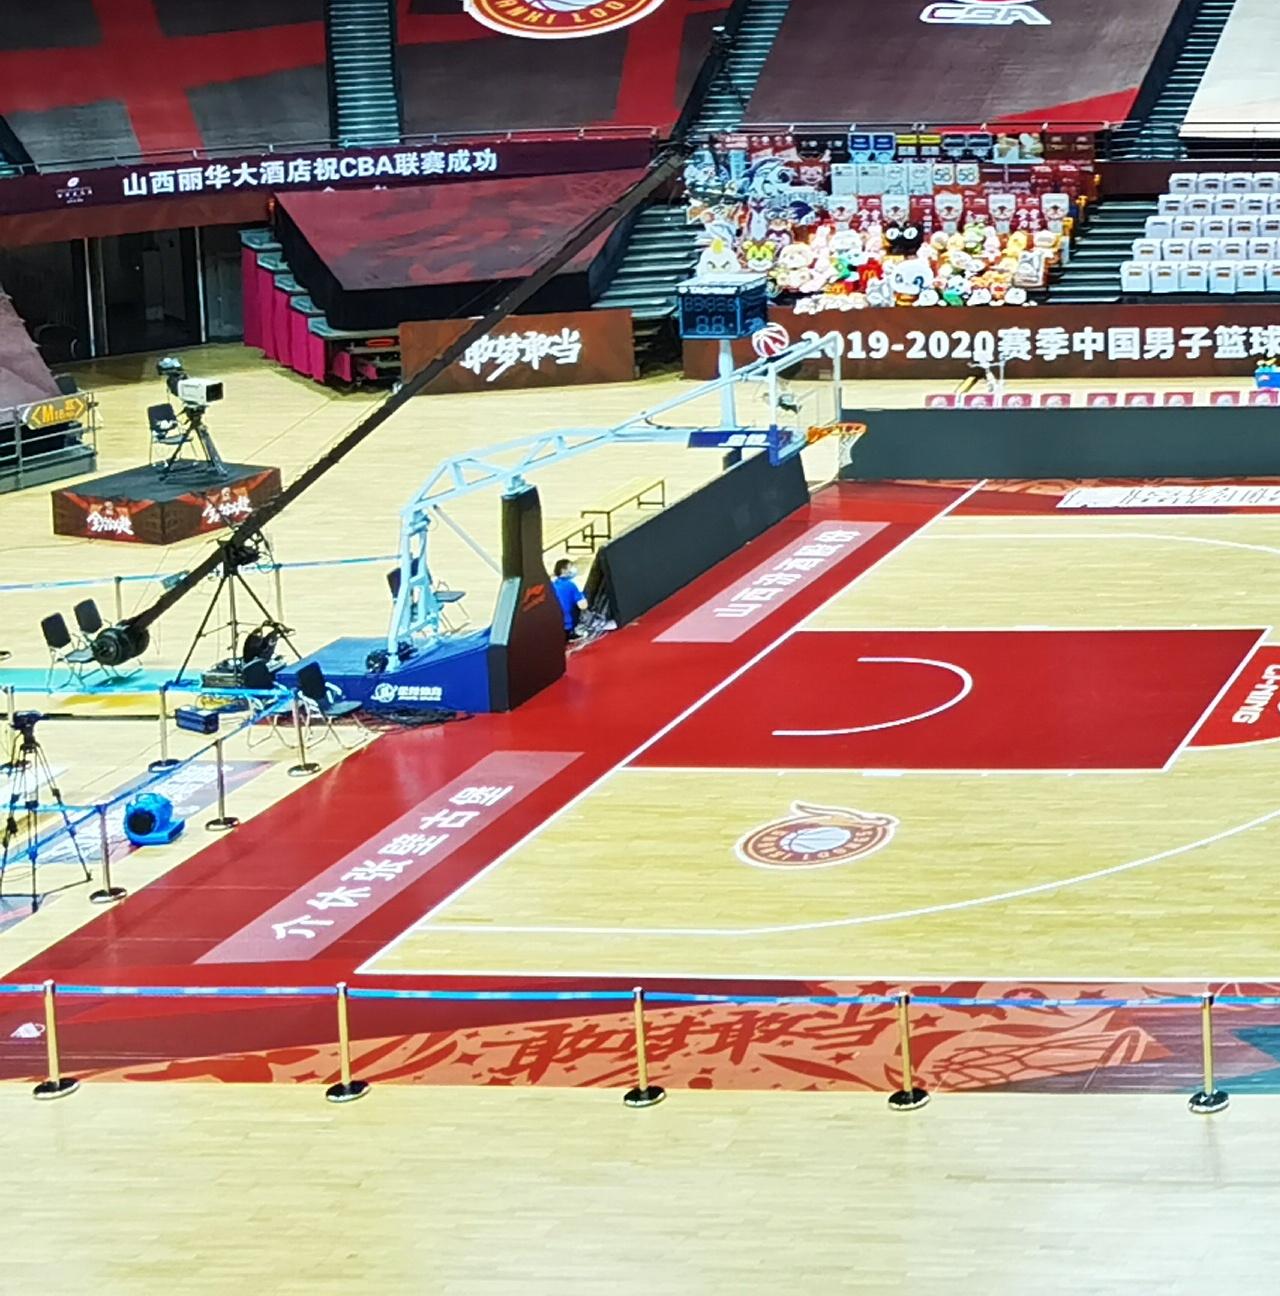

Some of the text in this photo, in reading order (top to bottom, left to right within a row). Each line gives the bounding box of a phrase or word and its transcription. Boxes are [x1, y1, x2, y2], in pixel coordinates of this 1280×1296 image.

[919, 2, 1052, 26] CBA
[122, 146, 499, 197] 山西丽华大酒店祝CBA联赛成功
